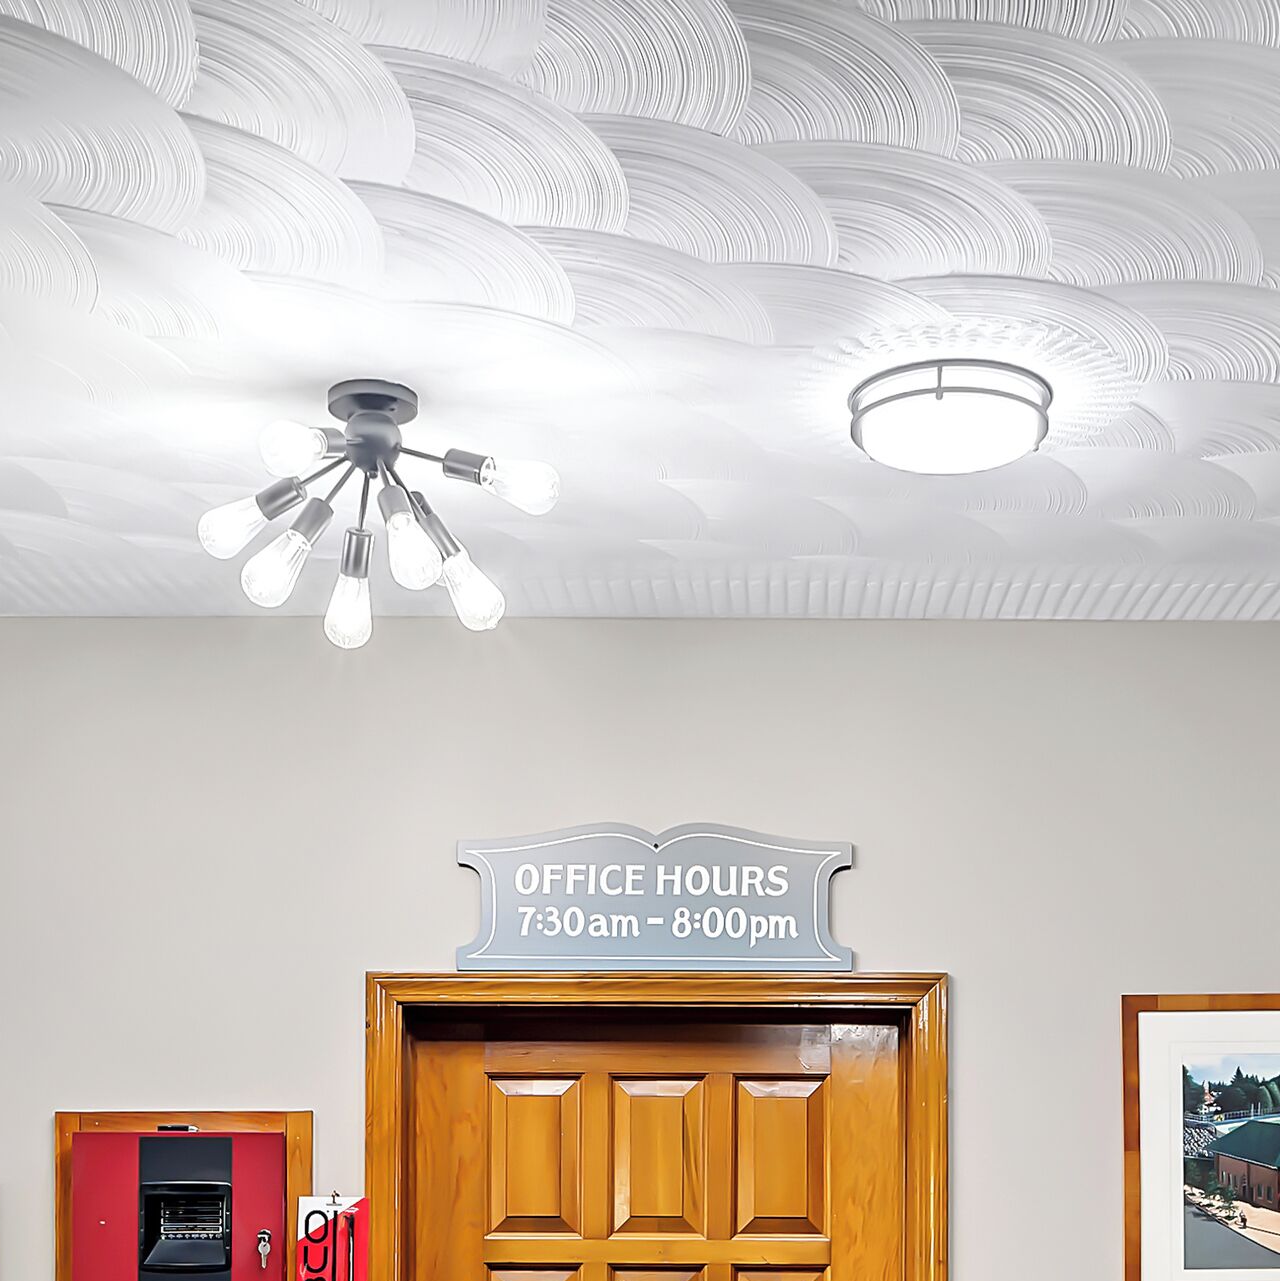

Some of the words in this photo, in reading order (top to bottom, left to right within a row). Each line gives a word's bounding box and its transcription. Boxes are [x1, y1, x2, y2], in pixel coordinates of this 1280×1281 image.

[514, 864, 645, 896] OFFICE
[656, 864, 789, 897] HOURS
[518, 906, 640, 938] 7:30am
[671, 906, 799, 948] 8:00pm
